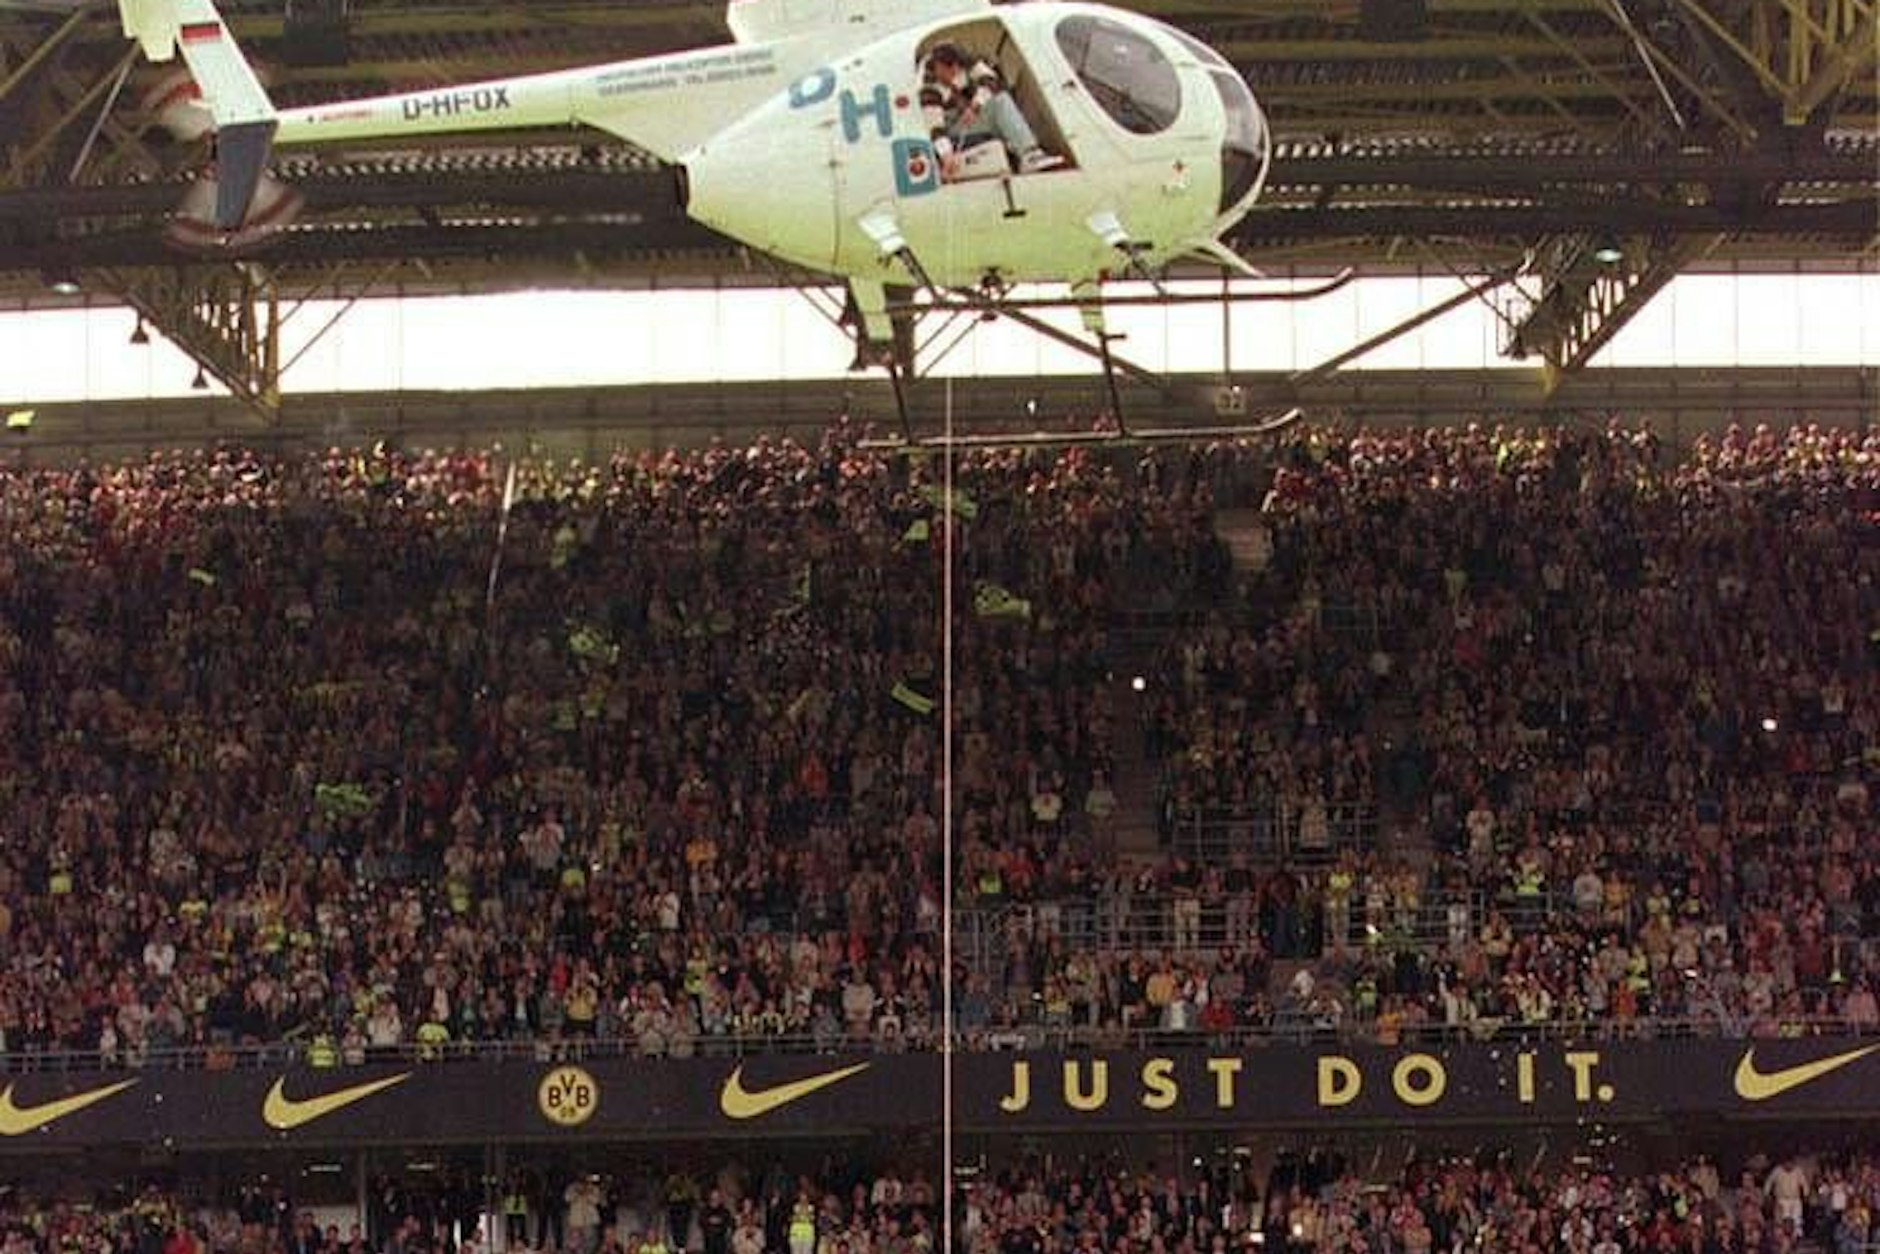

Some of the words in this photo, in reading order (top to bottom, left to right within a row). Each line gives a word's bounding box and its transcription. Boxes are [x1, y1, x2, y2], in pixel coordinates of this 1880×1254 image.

[547, 1073, 590, 1108] BVB
[1000, 1056, 1243, 1111] JUST
[1317, 1052, 1447, 1106] DO
